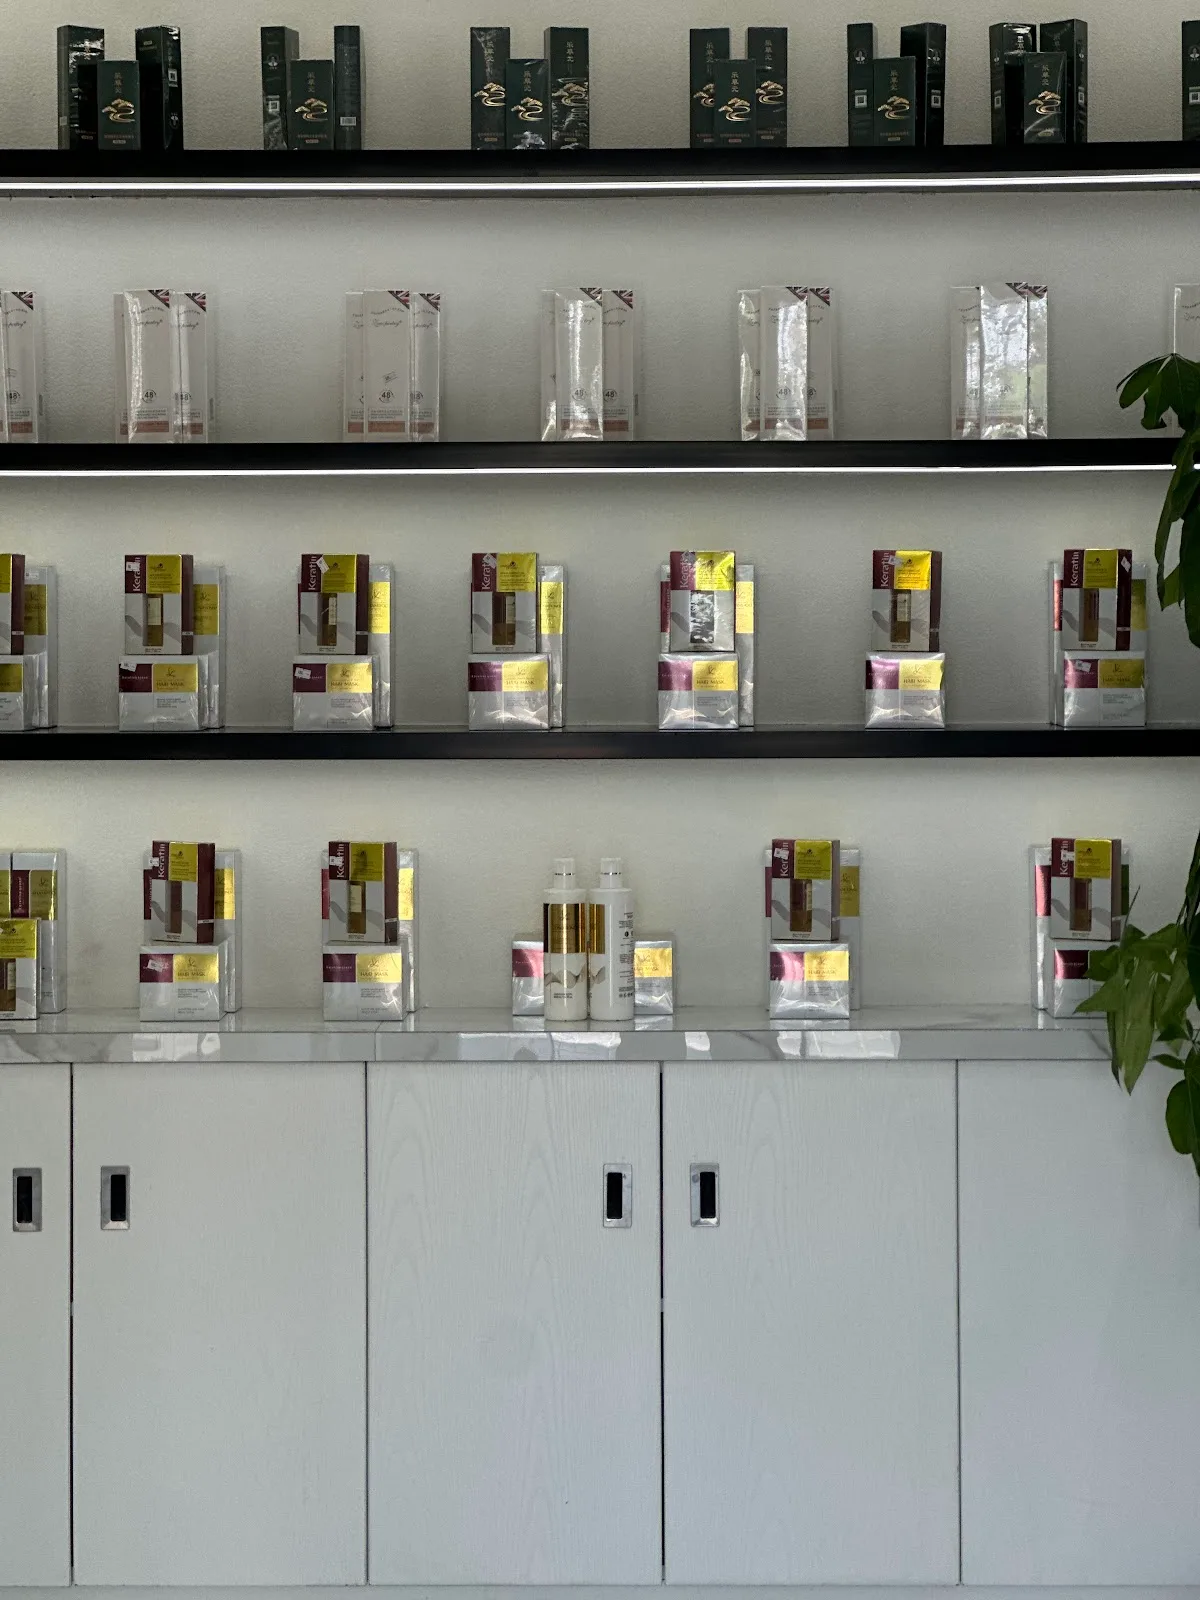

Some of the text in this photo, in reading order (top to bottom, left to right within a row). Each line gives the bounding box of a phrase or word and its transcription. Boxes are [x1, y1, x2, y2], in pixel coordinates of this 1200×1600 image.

[308, 556, 317, 590] Keratin
[881, 552, 889, 587] Keratin
[1070, 551, 1079, 586] Keratin
[158, 843, 166, 878] Keratin
